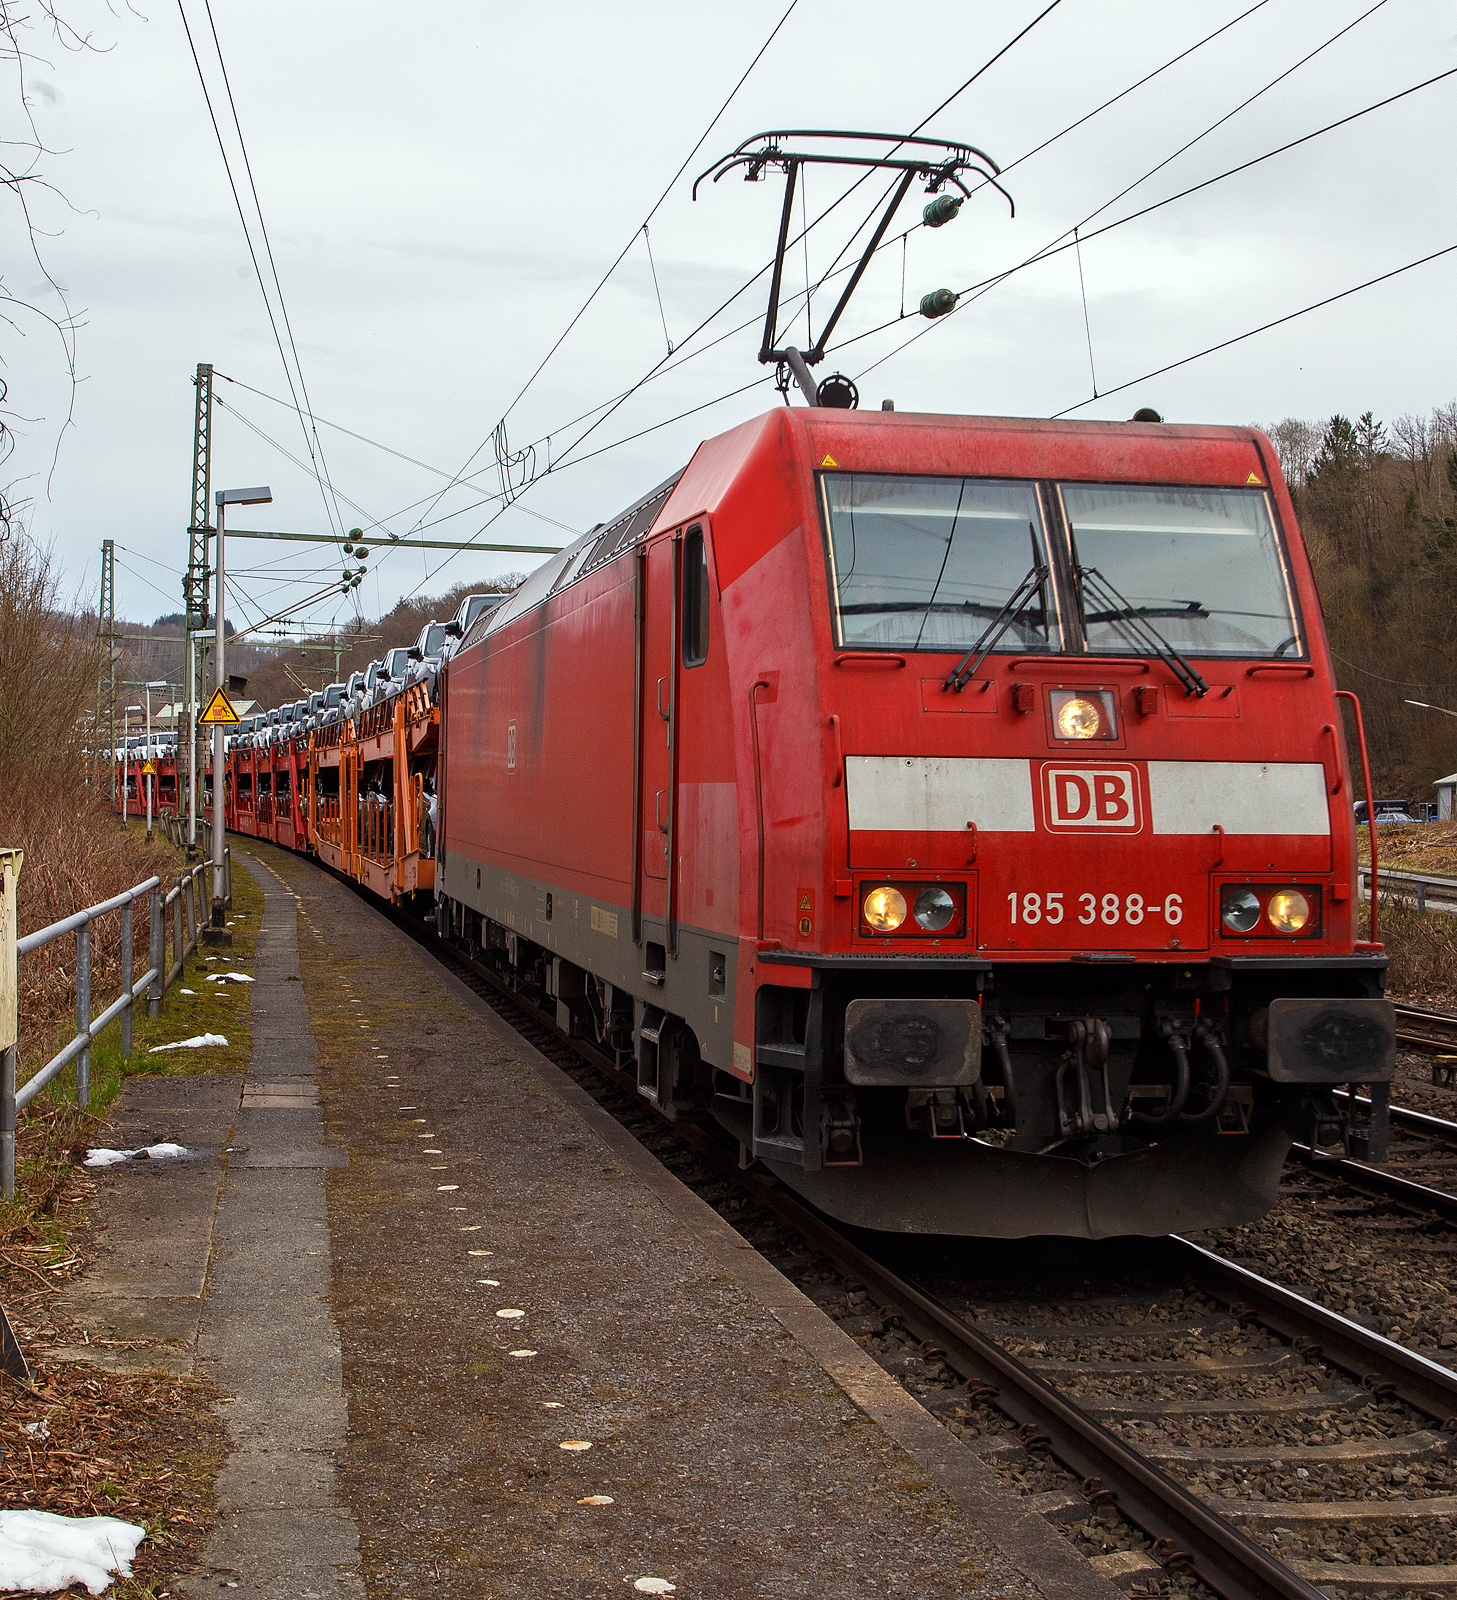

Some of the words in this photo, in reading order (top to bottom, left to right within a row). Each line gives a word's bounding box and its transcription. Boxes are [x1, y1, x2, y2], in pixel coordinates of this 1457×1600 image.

[1055, 774, 1129, 821] DB
[1007, 892, 1064, 925] 185
[1078, 892, 1183, 926] 388-6
